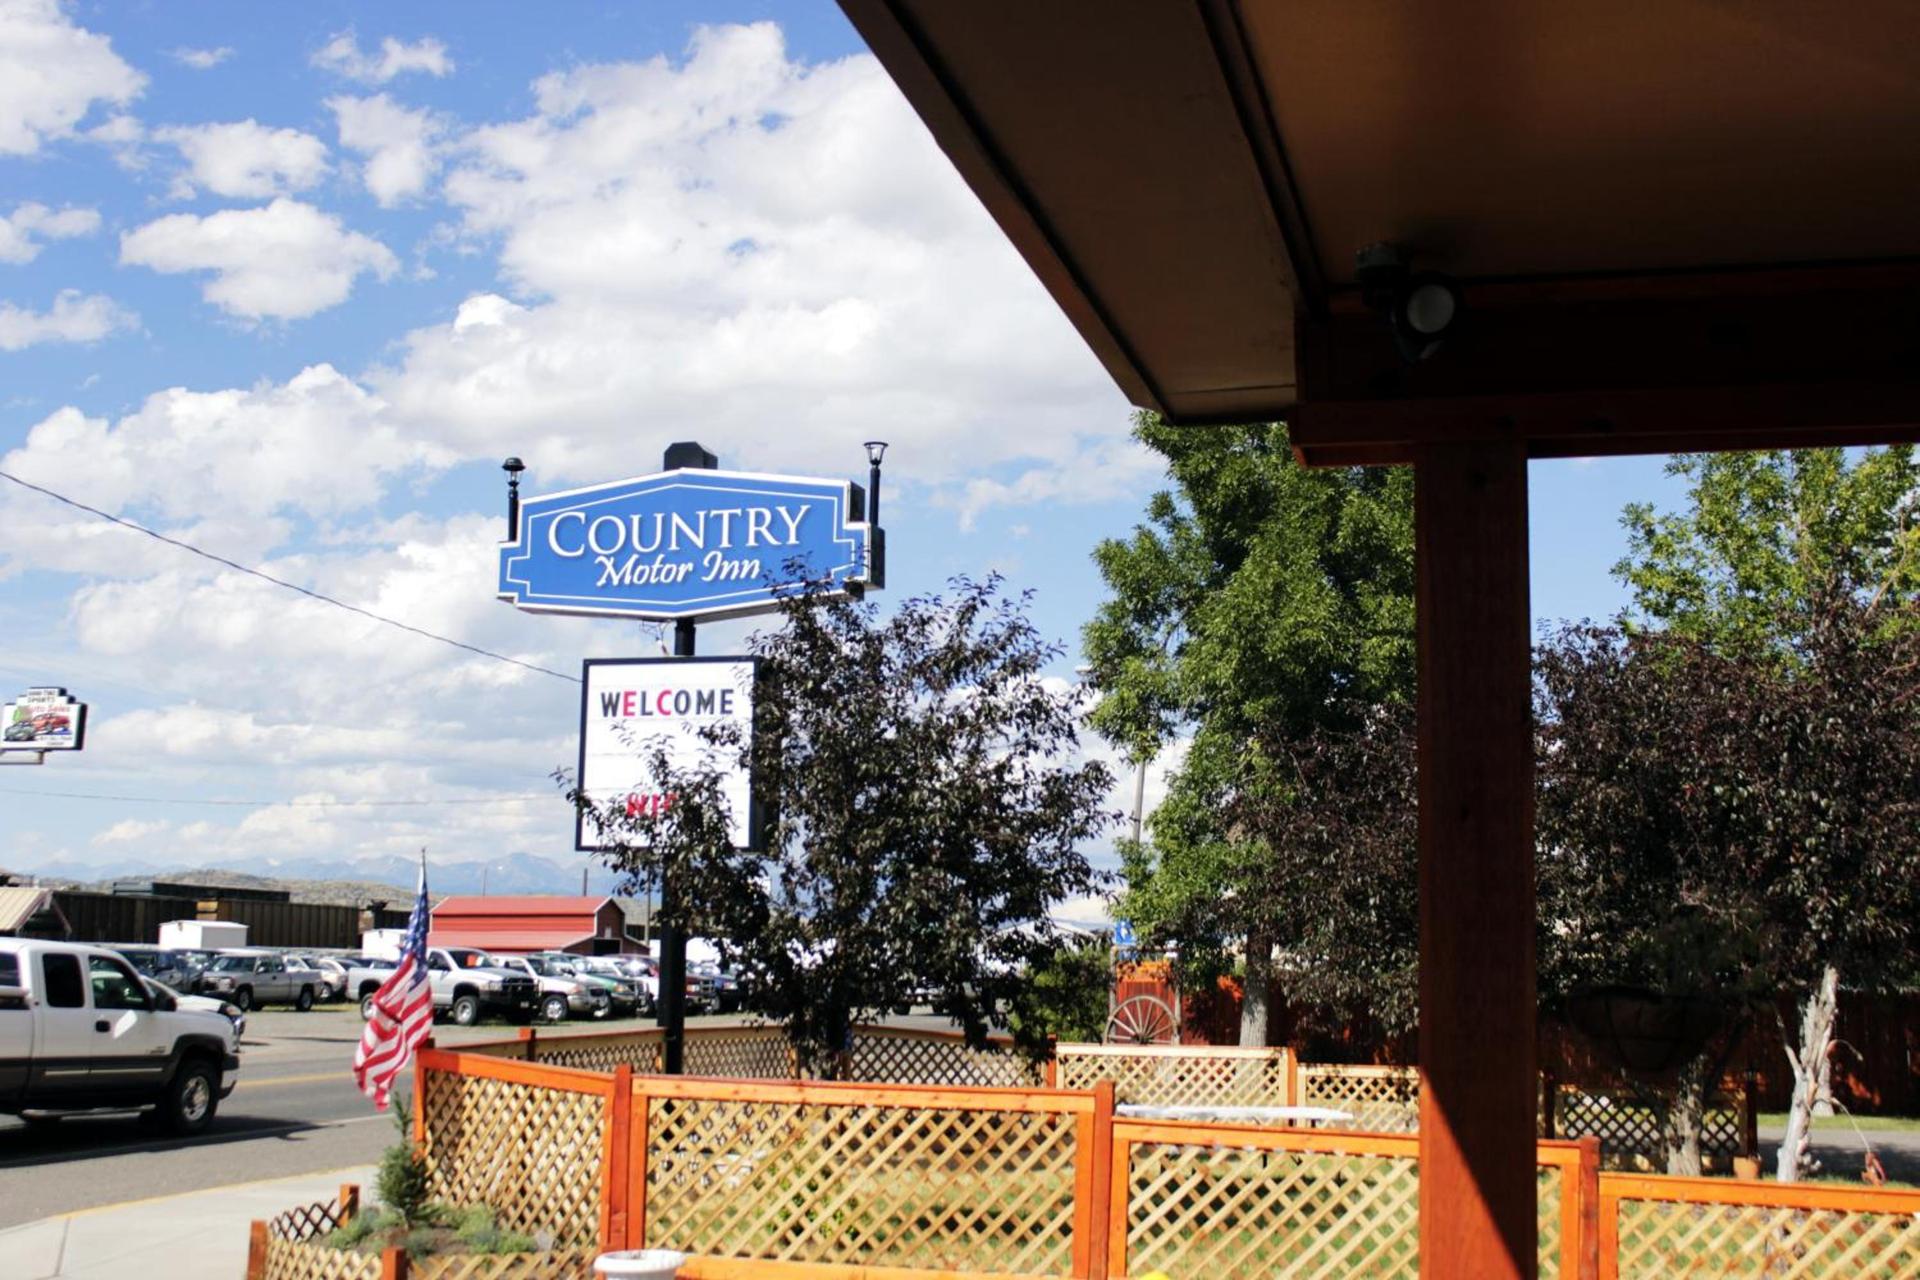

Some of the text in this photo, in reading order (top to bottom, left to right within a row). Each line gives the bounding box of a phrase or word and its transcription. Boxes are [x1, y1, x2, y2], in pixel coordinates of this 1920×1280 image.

[548, 504, 811, 557] COUNTRY
[595, 550, 761, 587] Motor Inn
[600, 689, 735, 717] WELCOME
